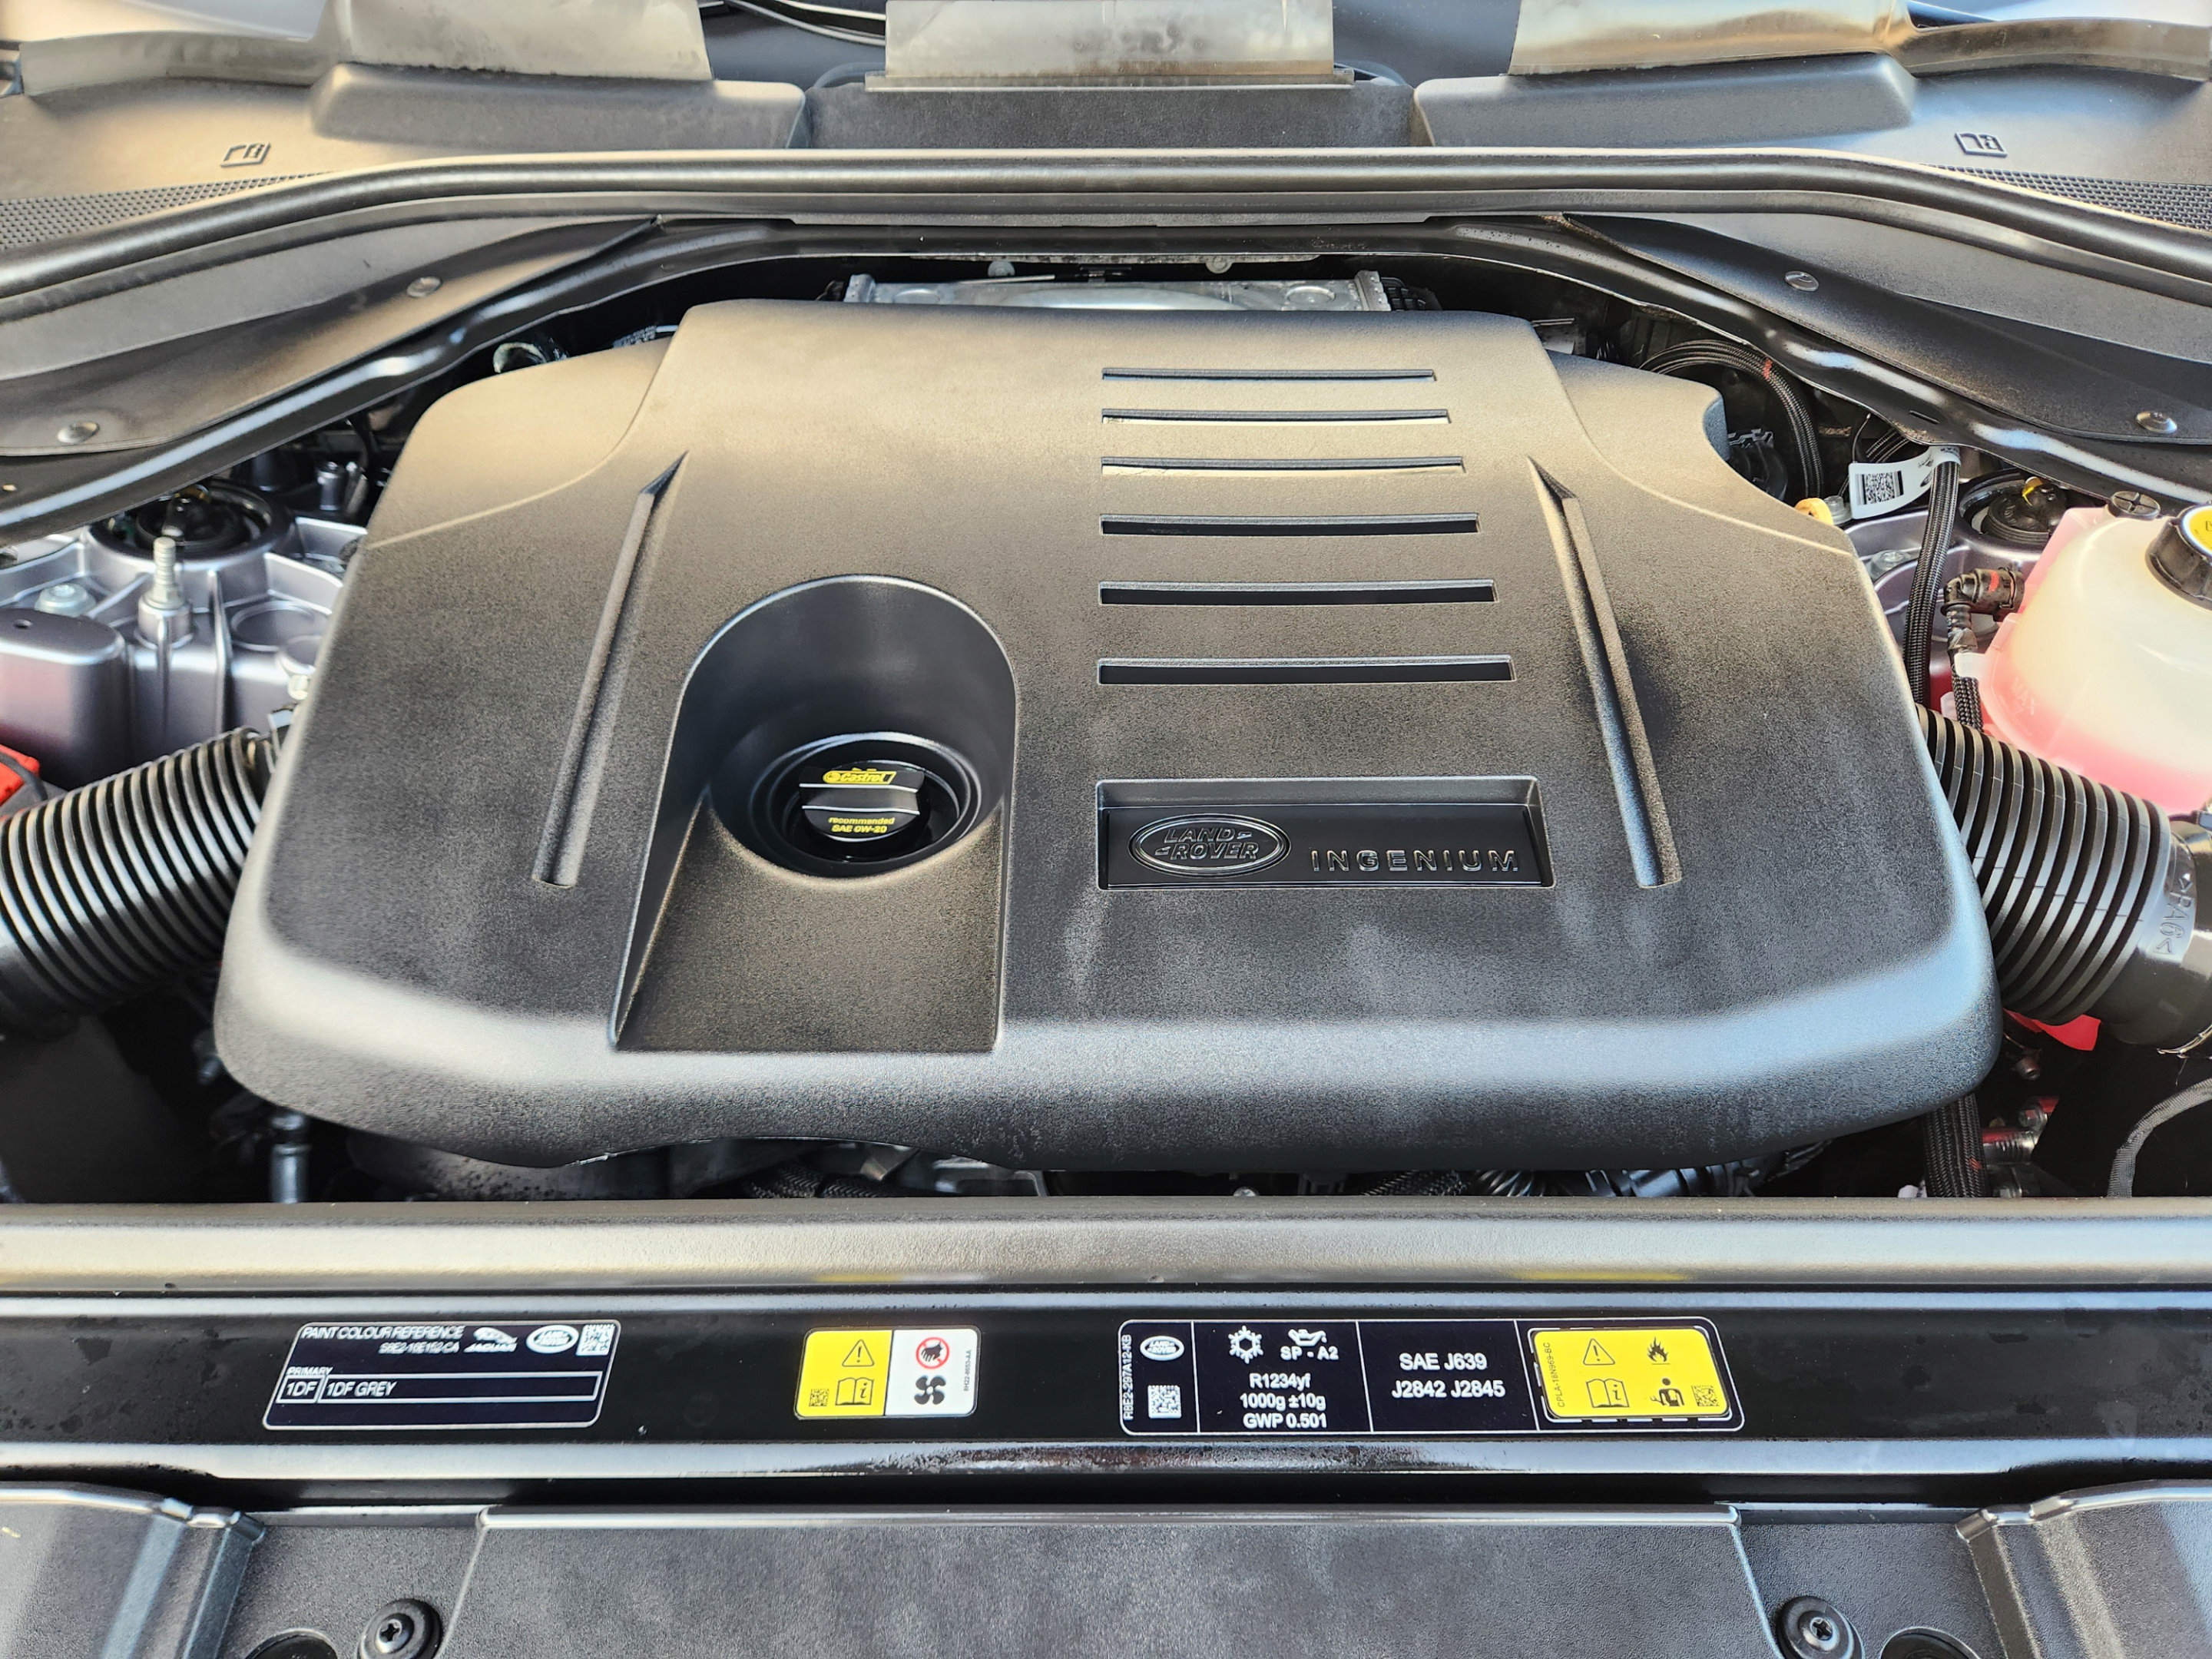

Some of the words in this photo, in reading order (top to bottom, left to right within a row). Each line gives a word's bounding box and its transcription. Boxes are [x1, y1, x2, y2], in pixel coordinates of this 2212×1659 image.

[839, 772, 886, 783] Castrol
[831, 824, 853, 833] SAE
[853, 825, 888, 833] 0W-20
[1164, 827, 1235, 843] LAND
[1170, 843, 1260, 860] ROVER
[1310, 849, 1519, 873] INGENIUM
[300, 1326, 339, 1339] PAINT
[336, 1326, 391, 1339] COLOUR
[390, 1326, 465, 1339] REFERENCE
[463, 1343, 518, 1353] JAGUAR
[1280, 1346, 1303, 1360] SP
[1317, 1346, 1339, 1360] A2
[1399, 1353, 1440, 1370] SAE
[1444, 1353, 1488, 1370] J639
[286, 1366, 333, 1376] PRIMARY
[1543, 1342, 1565, 1408] CPLA-18N969-BC
[286, 1381, 318, 1396] 1DF
[326, 1381, 356, 1396] 1DF
[354, 1381, 397, 1397] GREY
[1249, 1373, 1311, 1391] R1234yf
[1392, 1380, 1447, 1398] J2842
[1451, 1380, 1505, 1398] J2845
[1240, 1392, 1286, 1411] 1000g
[1288, 1392, 1326, 1411] ±10g
[1243, 1412, 1283, 1429] GWP
[1286, 1412, 1327, 1429] 0.501
